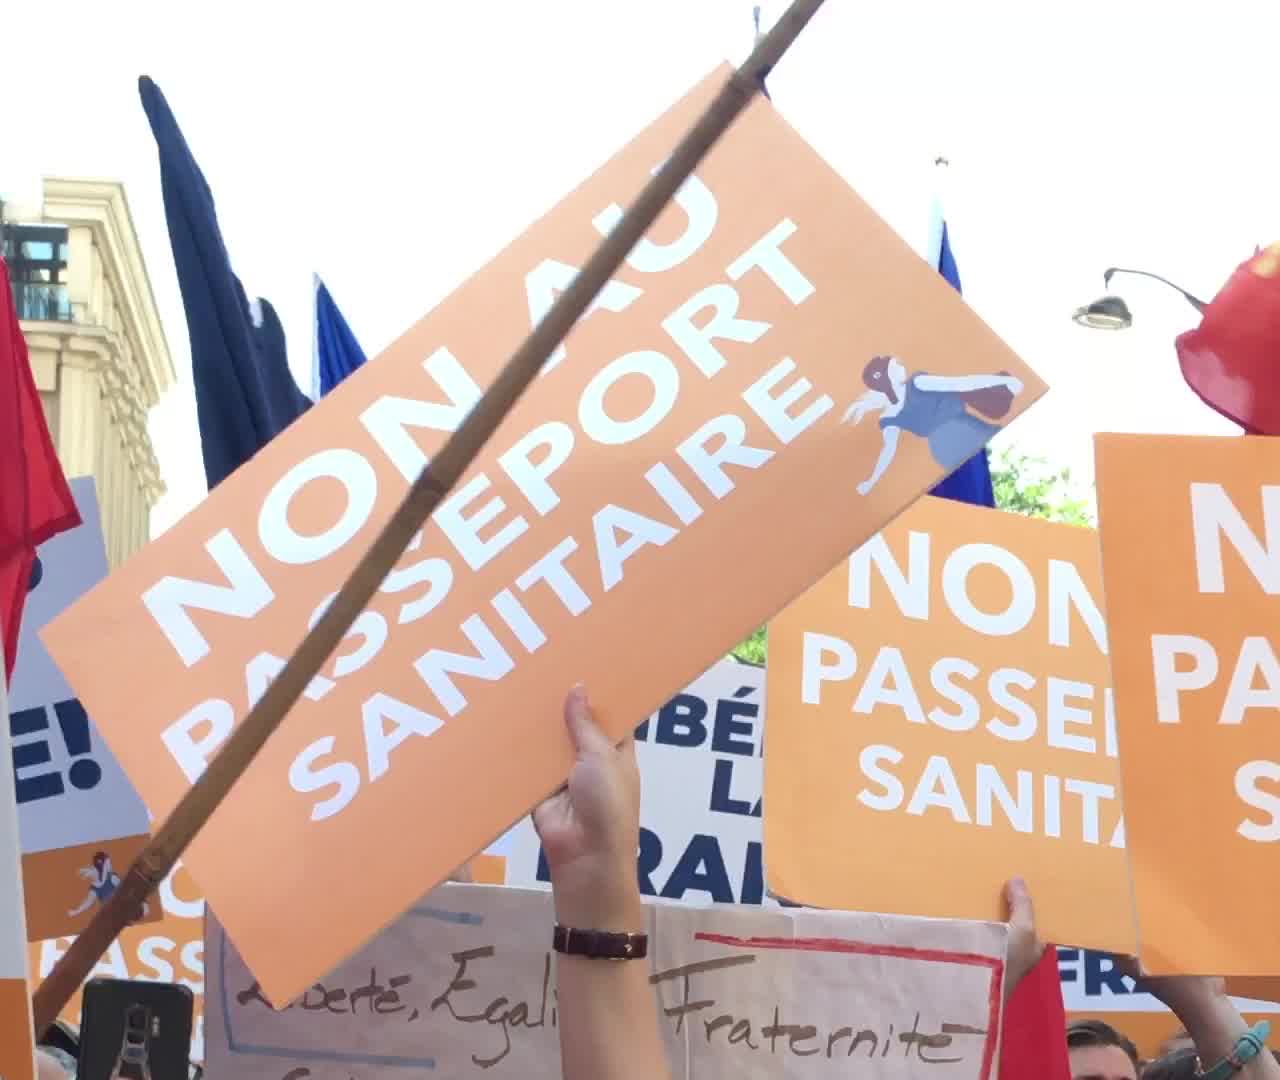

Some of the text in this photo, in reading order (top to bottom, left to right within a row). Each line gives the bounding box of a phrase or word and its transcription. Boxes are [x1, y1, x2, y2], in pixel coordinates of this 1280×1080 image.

[141, 162, 719, 668] NON AU
[288, 357, 835, 821] SANITAIRE
[848, 530, 1110, 656] NON
[634, 685, 763, 758] BÉ
[709, 758, 762, 817] L
[856, 744, 1126, 849] SANIT
[650, 954, 991, 1064] Fraternité
